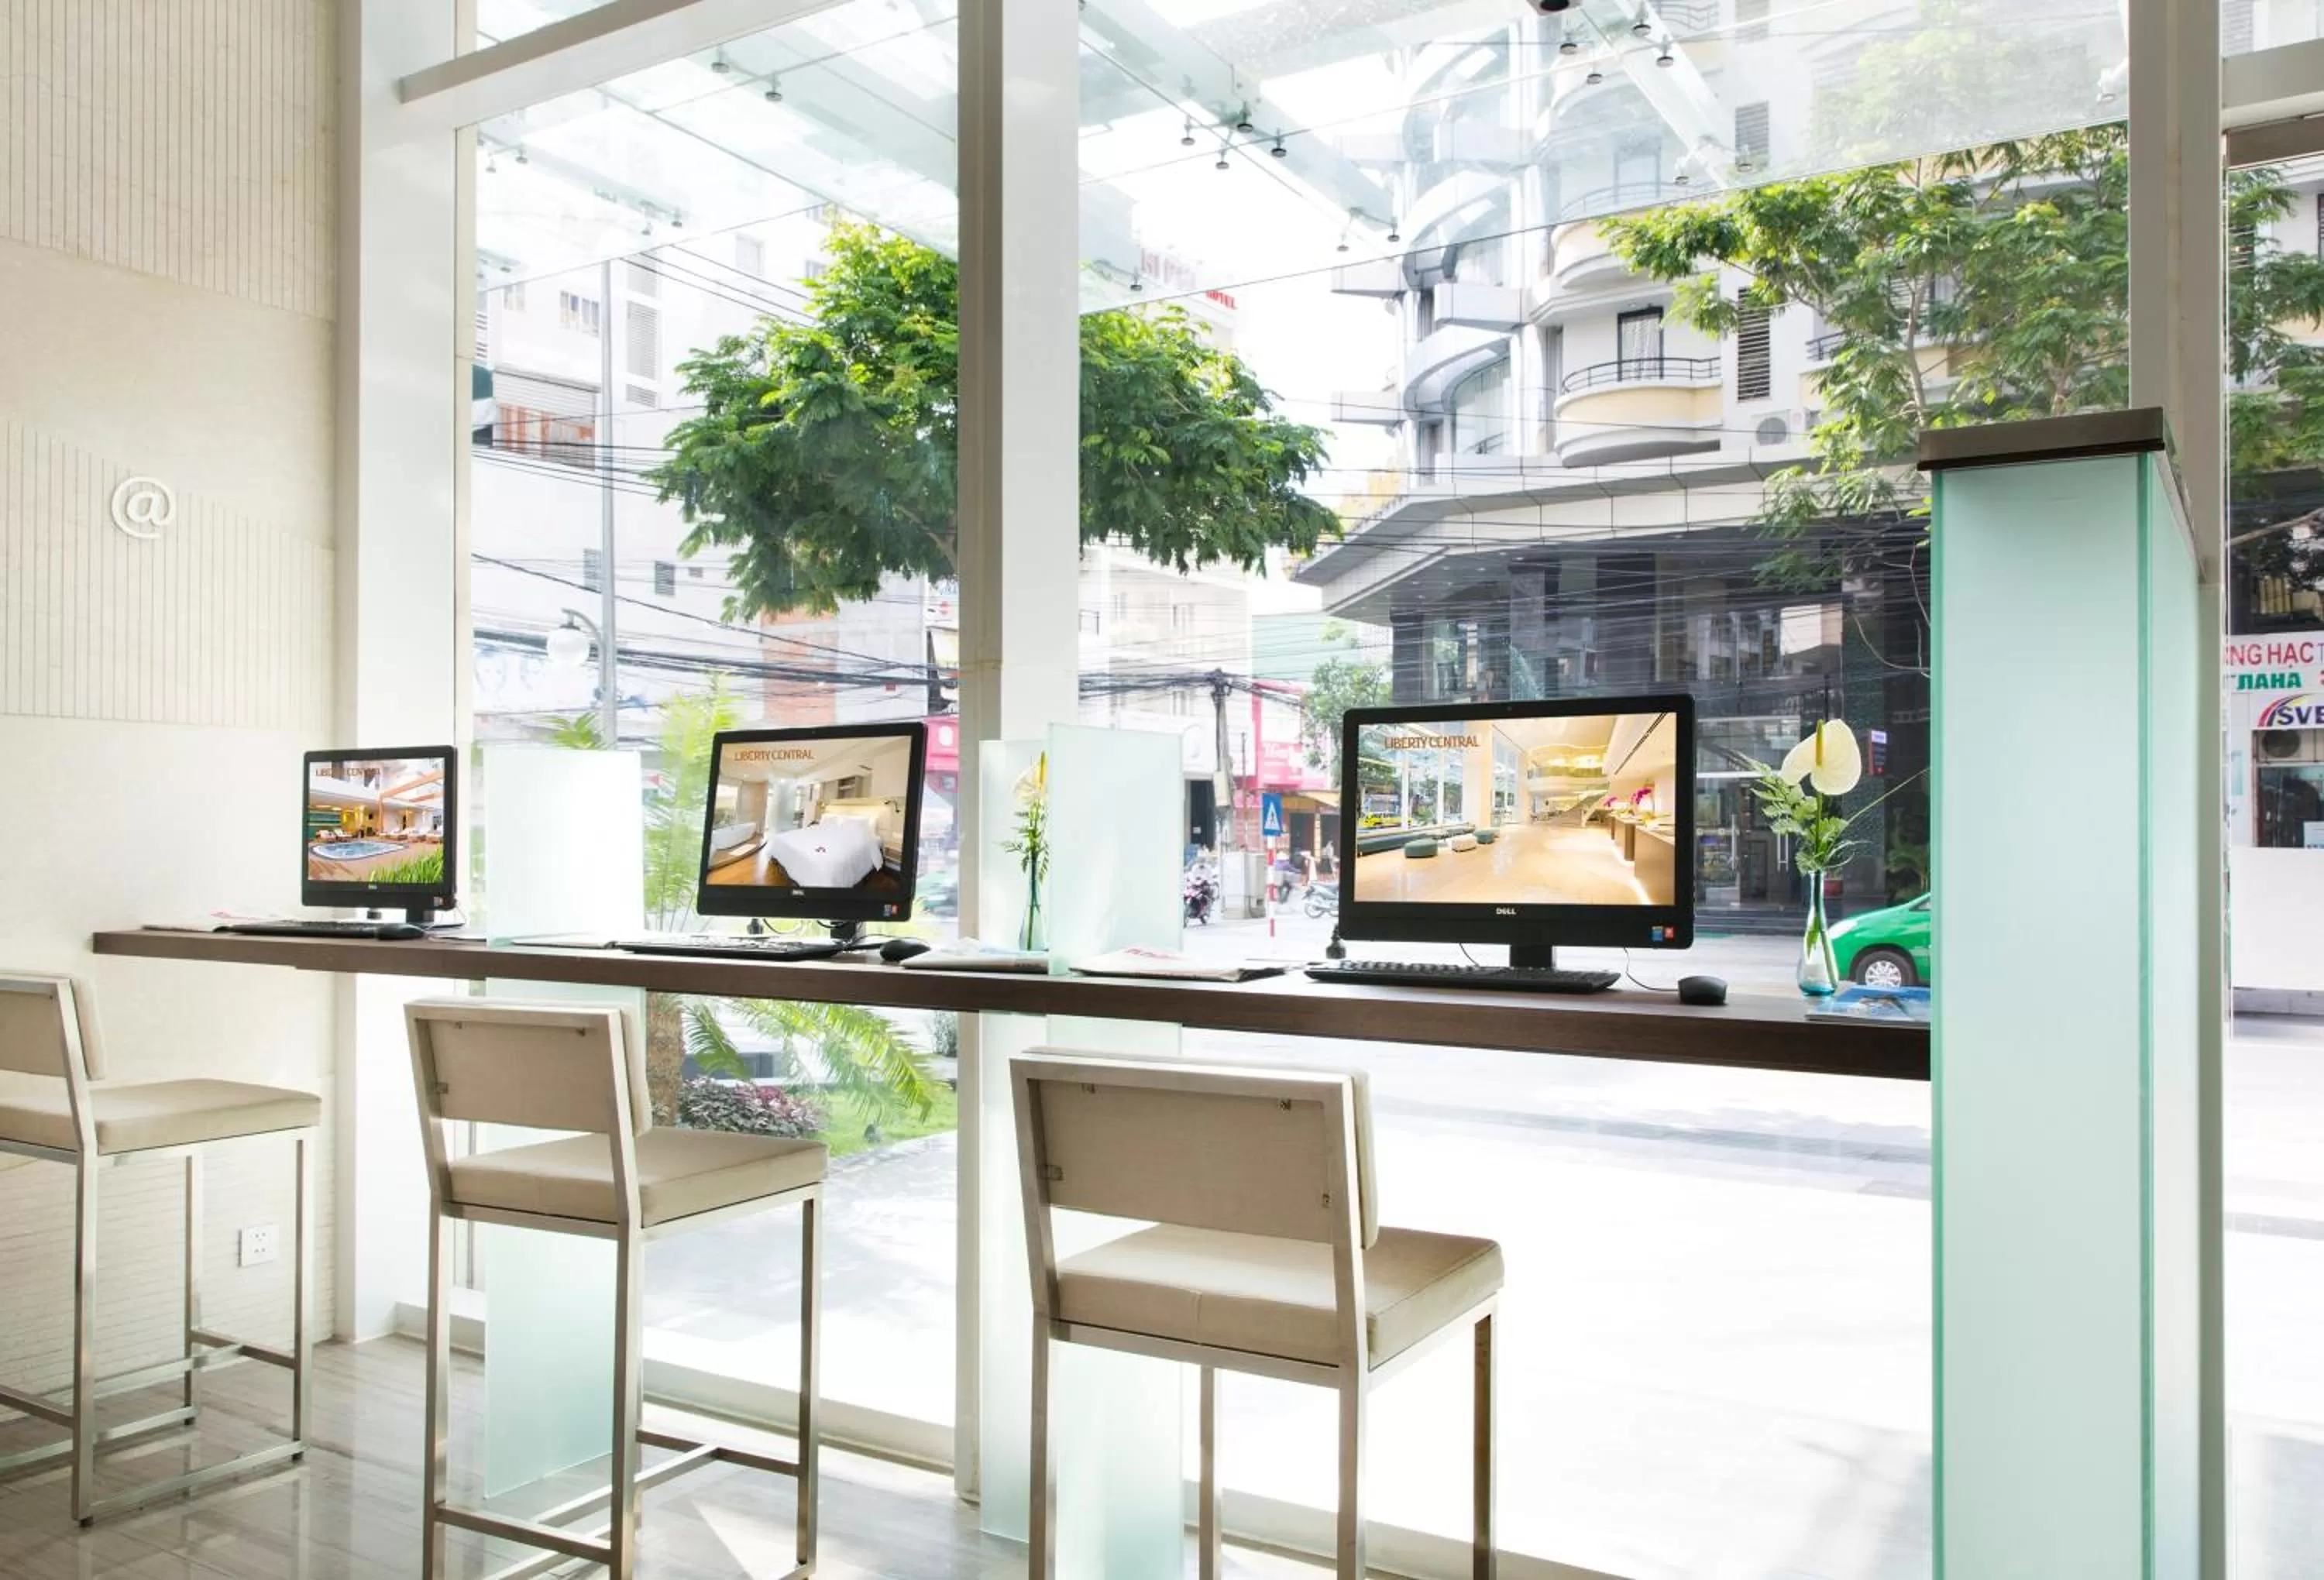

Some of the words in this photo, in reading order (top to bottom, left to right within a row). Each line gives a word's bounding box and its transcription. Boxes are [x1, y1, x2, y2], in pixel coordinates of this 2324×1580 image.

[2267, 641, 2314, 668] HẠC
[1385, 736, 1427, 749] LIBERTY
[1429, 734, 1480, 747] CENTRAL
[734, 749, 771, 761] LIBERTY
[772, 748, 815, 760] CENTRAL
[1496, 907, 1518, 915] DELL
